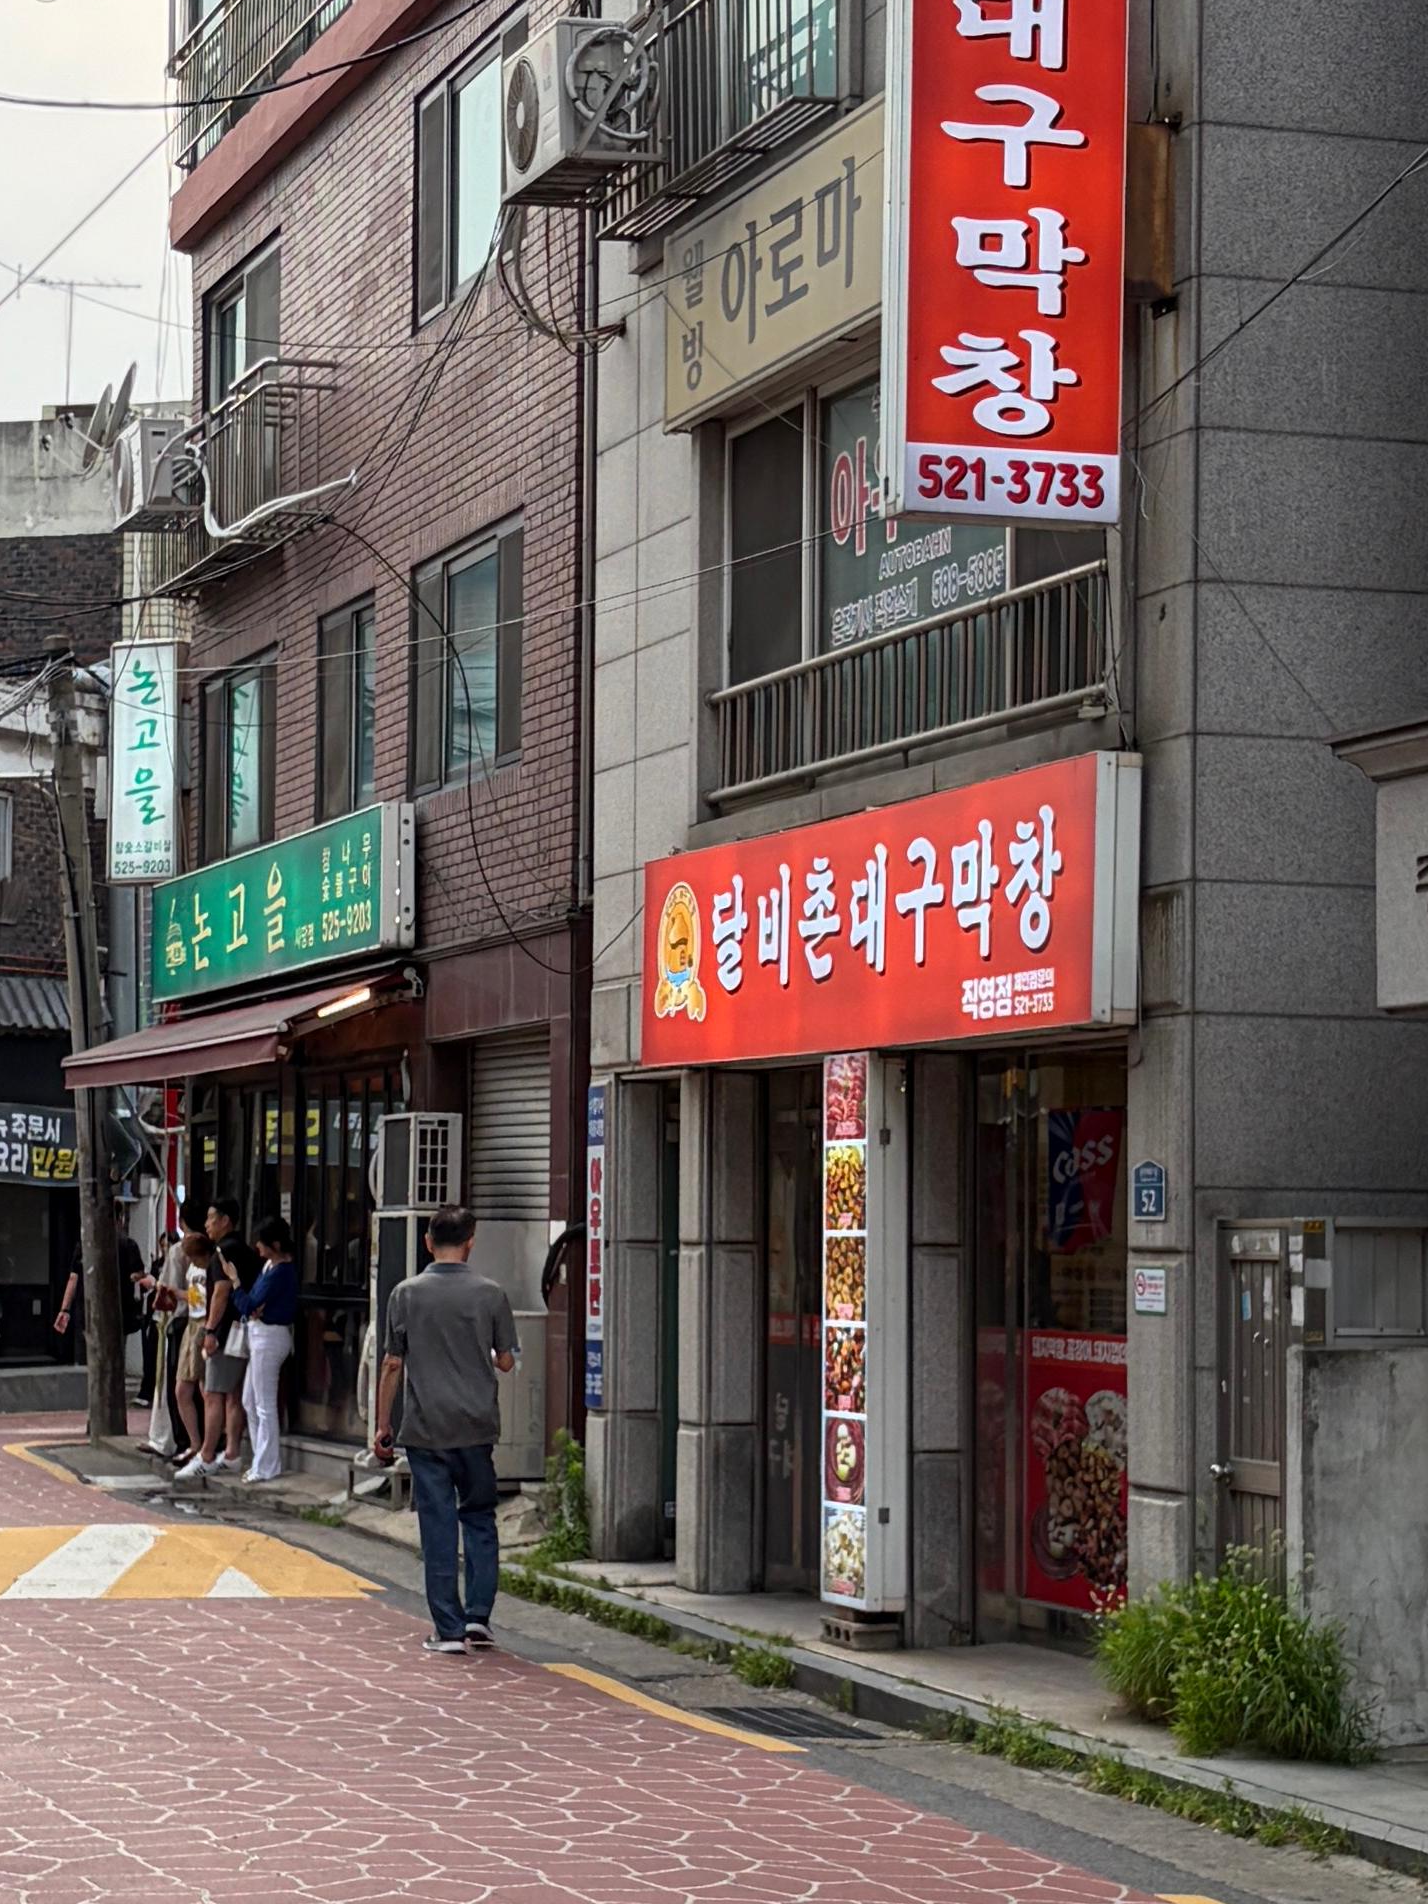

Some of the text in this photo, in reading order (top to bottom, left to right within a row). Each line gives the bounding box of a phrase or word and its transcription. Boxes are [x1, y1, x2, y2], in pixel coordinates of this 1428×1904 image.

[721, 154, 863, 346] 아로마
[682, 239, 705, 392] 웰빙
[917, 453, 1106, 509] 521-3733
[878, 526, 952, 581] AUTOBAHN
[124, 659, 167, 827] 논고을
[114, 858, 172, 875] 525-9203
[190, 861, 293, 972] 논고을
[321, 898, 373, 944] 525-9203
[961, 973, 1013, 1021] 직영점
[10, 1112, 62, 1144] 주문시
[1141, 1189, 1157, 1213] 52
